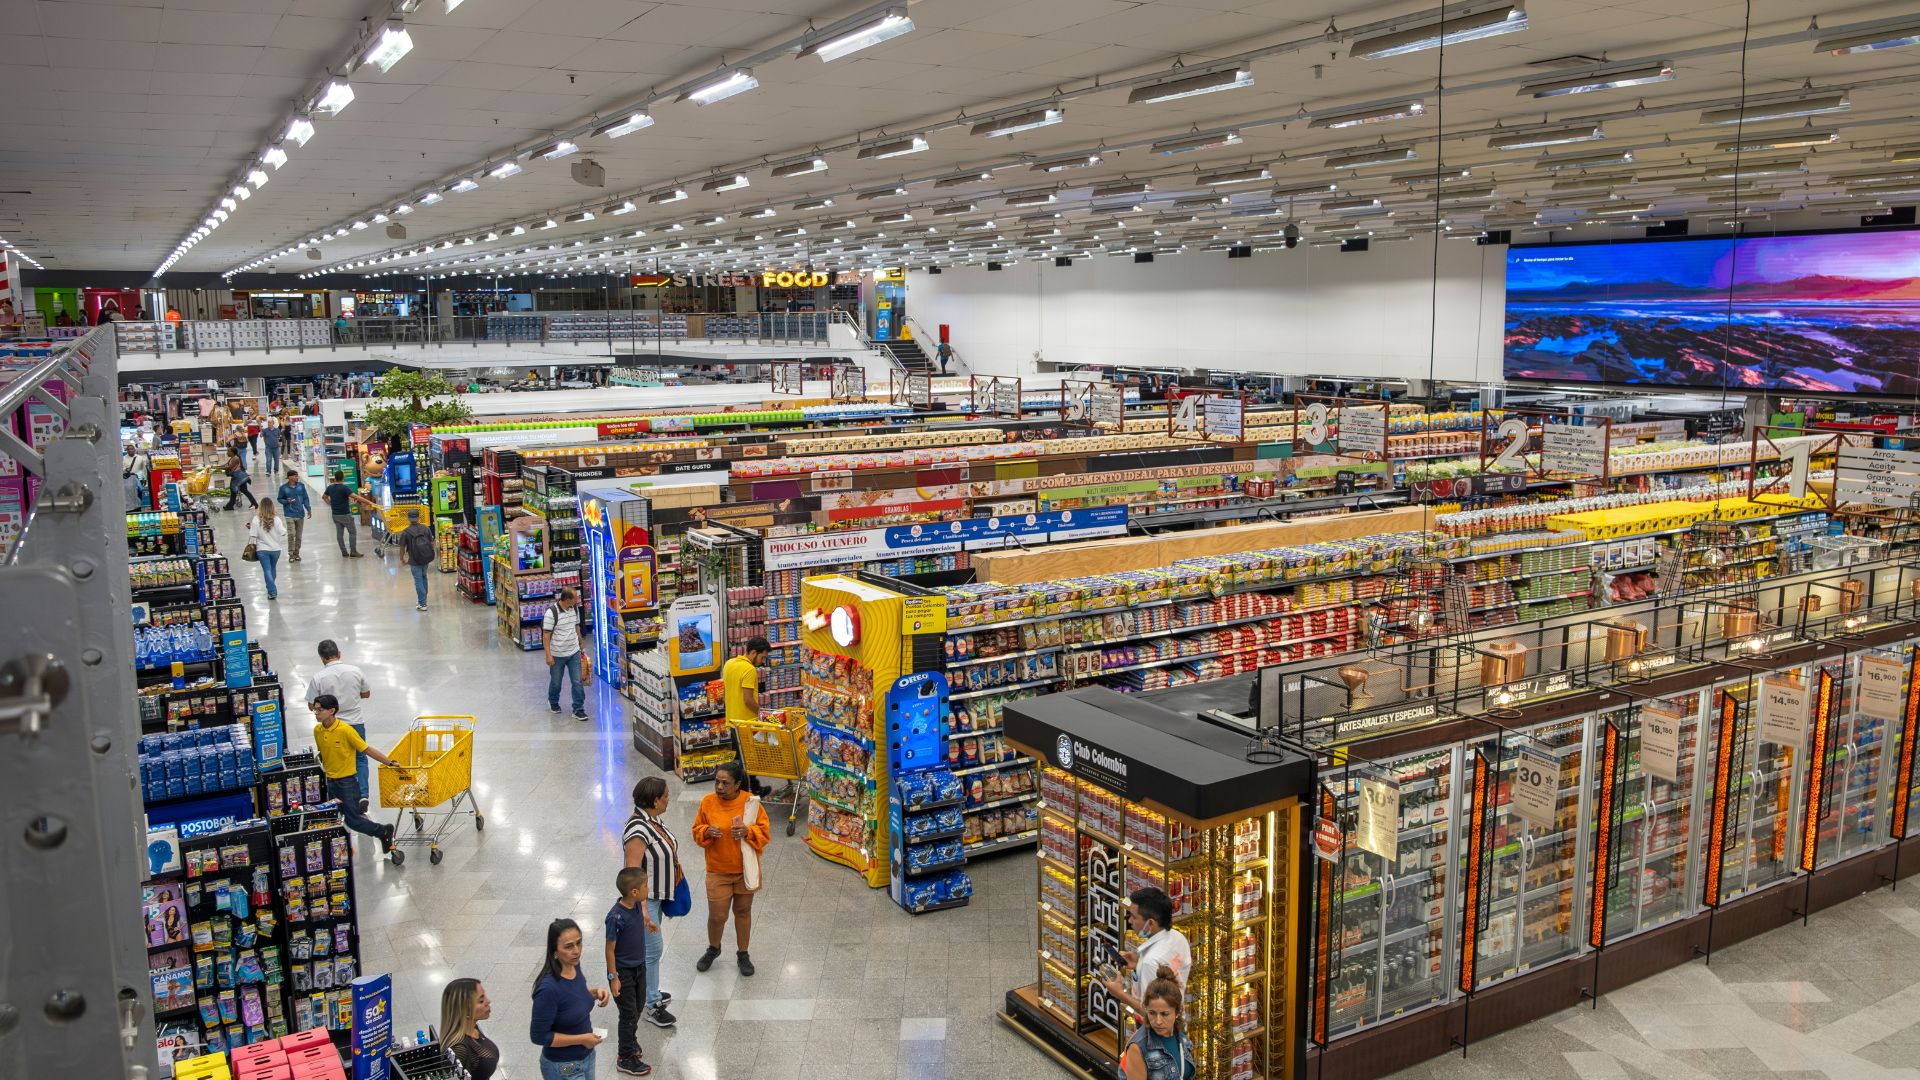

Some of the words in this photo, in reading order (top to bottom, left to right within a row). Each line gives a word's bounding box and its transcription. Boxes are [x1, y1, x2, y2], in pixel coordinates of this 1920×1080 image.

[673, 273, 760, 287] STREET
[763, 272, 828, 287] FOOD
[833, 366, 846, 397] 8
[976, 380, 990, 410] 6
[1175, 394, 1197, 433] 4
[1304, 402, 1327, 445] 3
[1496, 420, 1529, 468] 2
[1872, 450, 1896, 459] Arroz
[1558, 464, 1587, 472] Mayonesa
[1780, 440, 1811, 498] 1
[1869, 462, 1896, 471] Aceite
[1025, 480, 1039, 490] EL
[1040, 474, 1122, 489] COMPLEMENTO
[1123, 468, 1154, 480] IDEAL
[1157, 468, 1185, 479] PARA
[1186, 467, 1200, 476] TU
[1202, 463, 1253, 475] DESAYUNO
[1866, 473, 1896, 483] Granos
[1865, 484, 1895, 494] Azucar
[1872, 496, 1885, 504] Sal
[884, 505, 909, 513] GRANOLAS
[769, 541, 818, 554] PROCESO
[820, 535, 868, 549] ATUNERO
[875, 551, 896, 559] Atunes
[901, 547, 925, 555] mezclas
[926, 545, 956, 554] especiales
[803, 558, 830, 566] mezclas
[830, 554, 863, 564] especiales
[899, 673, 928, 688] OREO
[1549, 674, 1566, 685] SUPER
[1545, 682, 1570, 694] PREMIUM
[1338, 713, 1389, 733] ARTESANALES
[1389, 713, 1395, 722] Y
[1394, 704, 1435, 721] ESPECIALES
[1074, 741, 1090, 760] Club
[1092, 748, 1127, 777] Colombia
[1520, 766, 1542, 787] 30
[1321, 823, 1335, 835] PARE
[148, 905, 160, 920] 15
[365, 1005, 379, 1019] 50
[158, 1035, 174, 1049] aló
